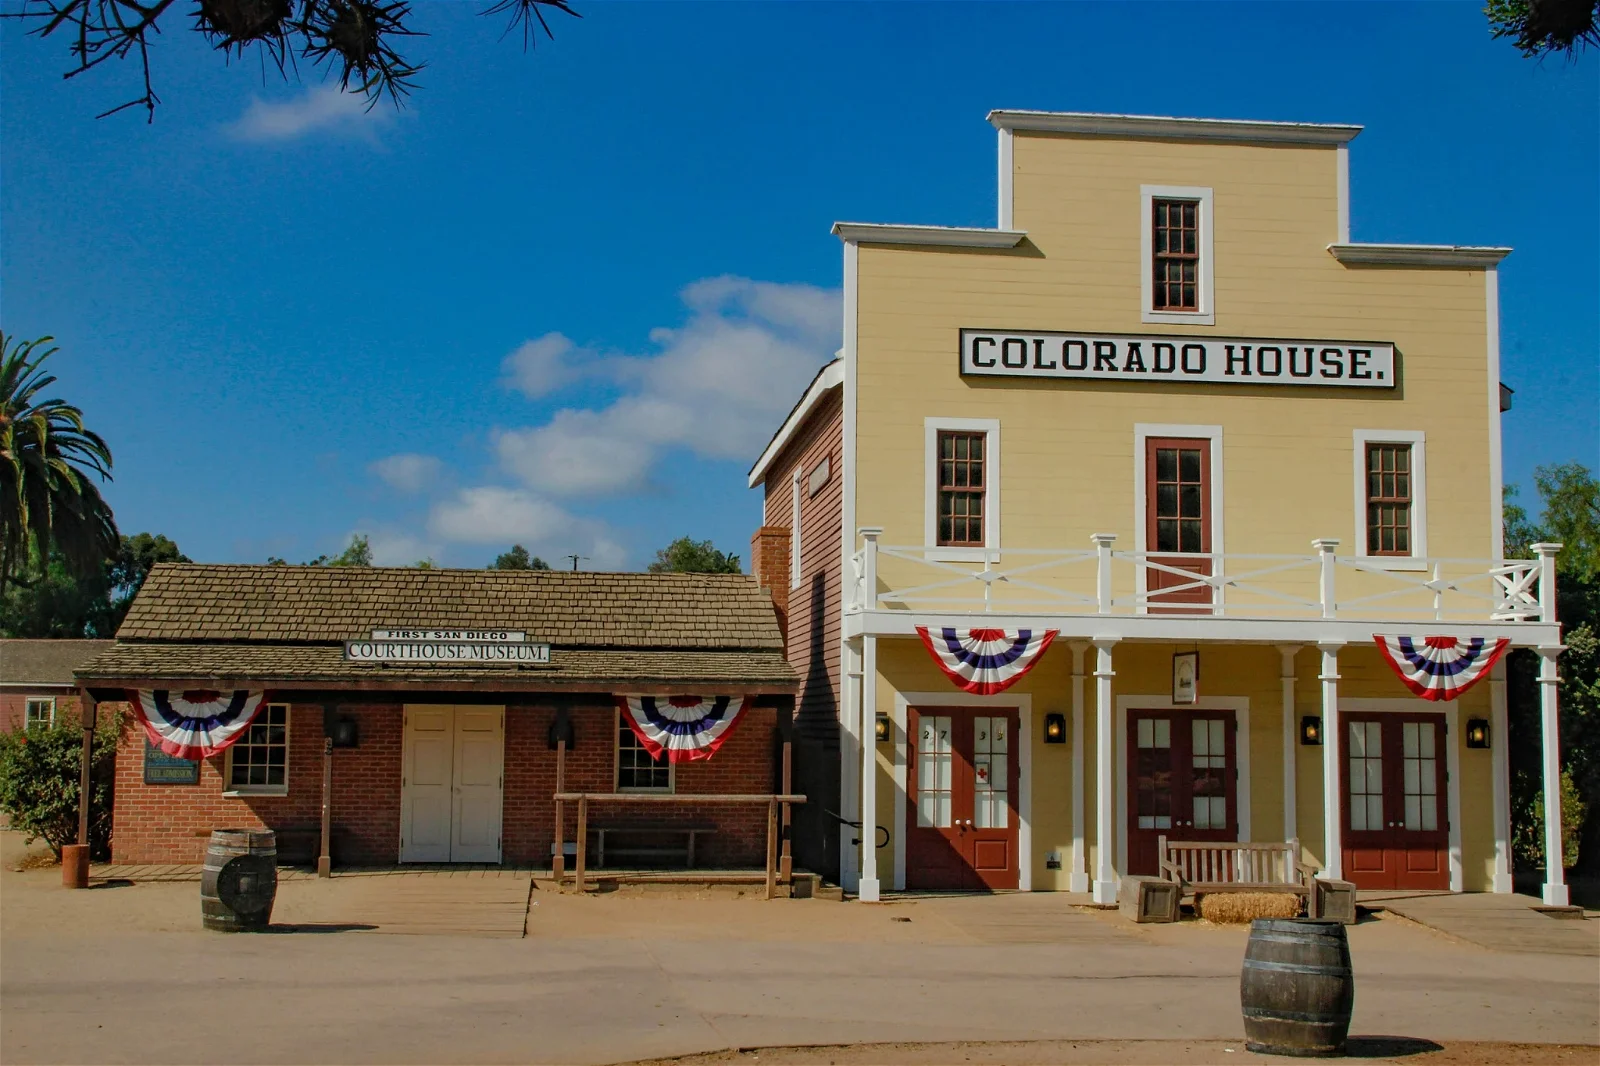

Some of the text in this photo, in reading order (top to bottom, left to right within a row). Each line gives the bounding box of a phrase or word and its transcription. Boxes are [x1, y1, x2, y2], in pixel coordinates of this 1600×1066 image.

[972, 337, 1384, 379] COLORADO HOUSE.
[434, 631, 460, 639] SAN
[349, 643, 546, 660] COURTHOUSE MUSEUM.
[923, 730, 930, 740] 2
[941, 730, 947, 740] 7
[979, 731, 986, 740] 3
